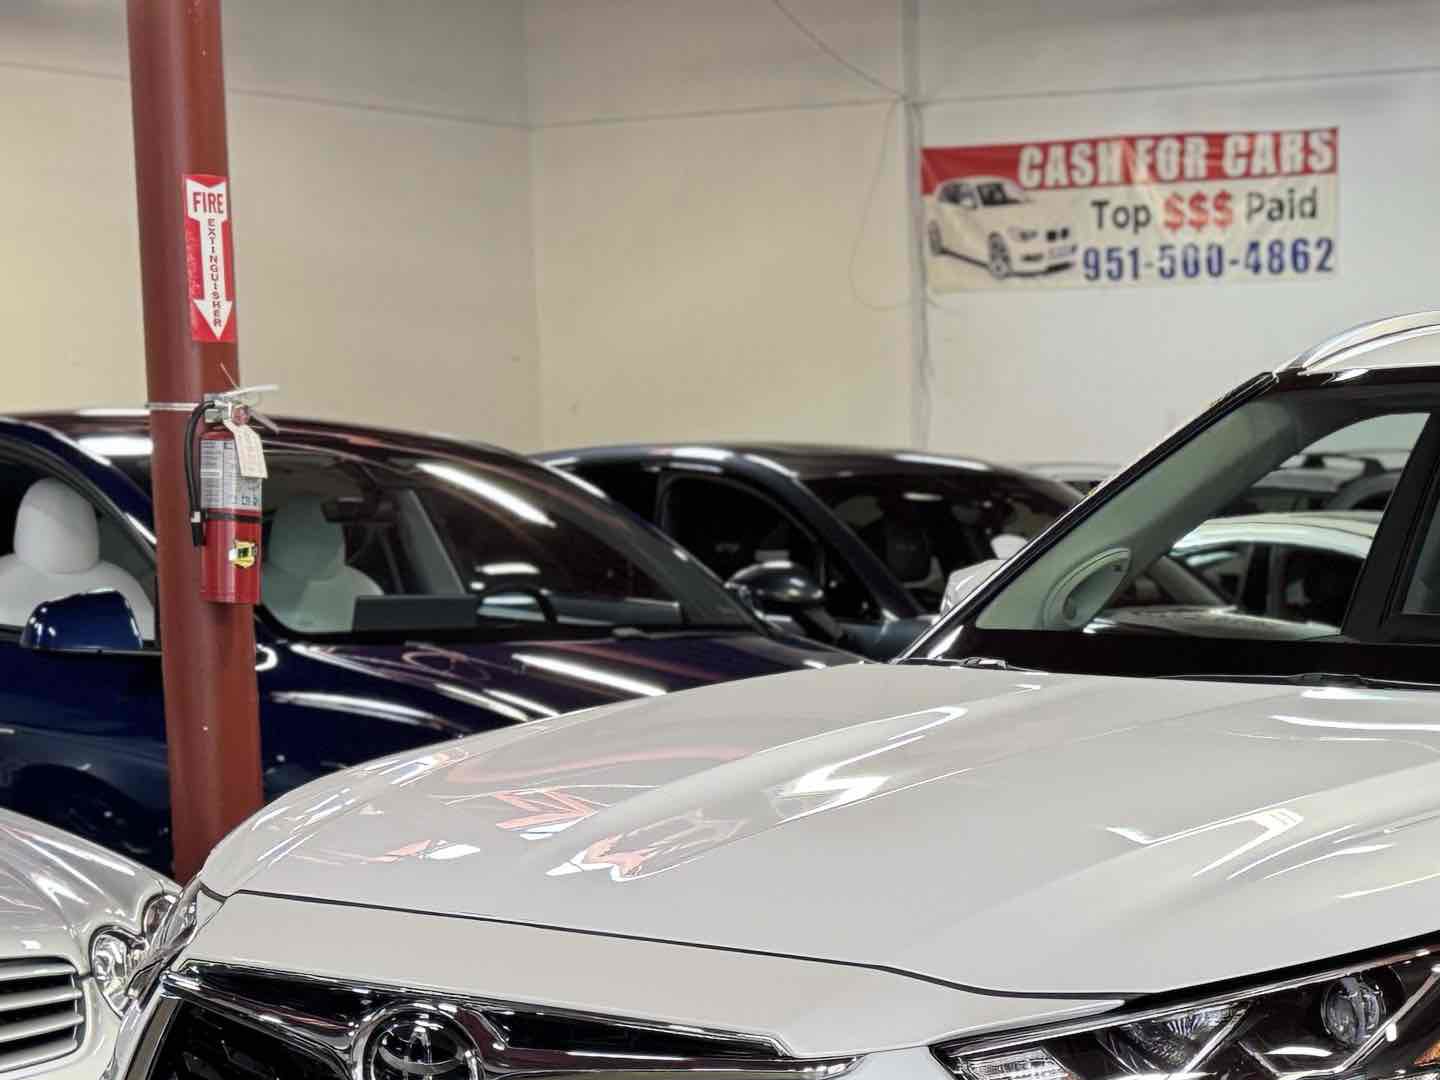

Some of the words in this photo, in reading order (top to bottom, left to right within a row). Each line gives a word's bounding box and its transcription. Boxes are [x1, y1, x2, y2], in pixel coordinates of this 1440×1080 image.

[1017, 138, 1124, 189] CASH
[1133, 135, 1210, 184] FOR
[1222, 129, 1335, 178] CARS
[192, 191, 224, 214] FIRE
[1091, 200, 1152, 234] Top
[1162, 190, 1234, 232] $$$
[1245, 188, 1319, 222] Paid
[207, 218, 222, 327] EXTINGUISHER
[1082, 237, 1335, 282] 951-500-4862
